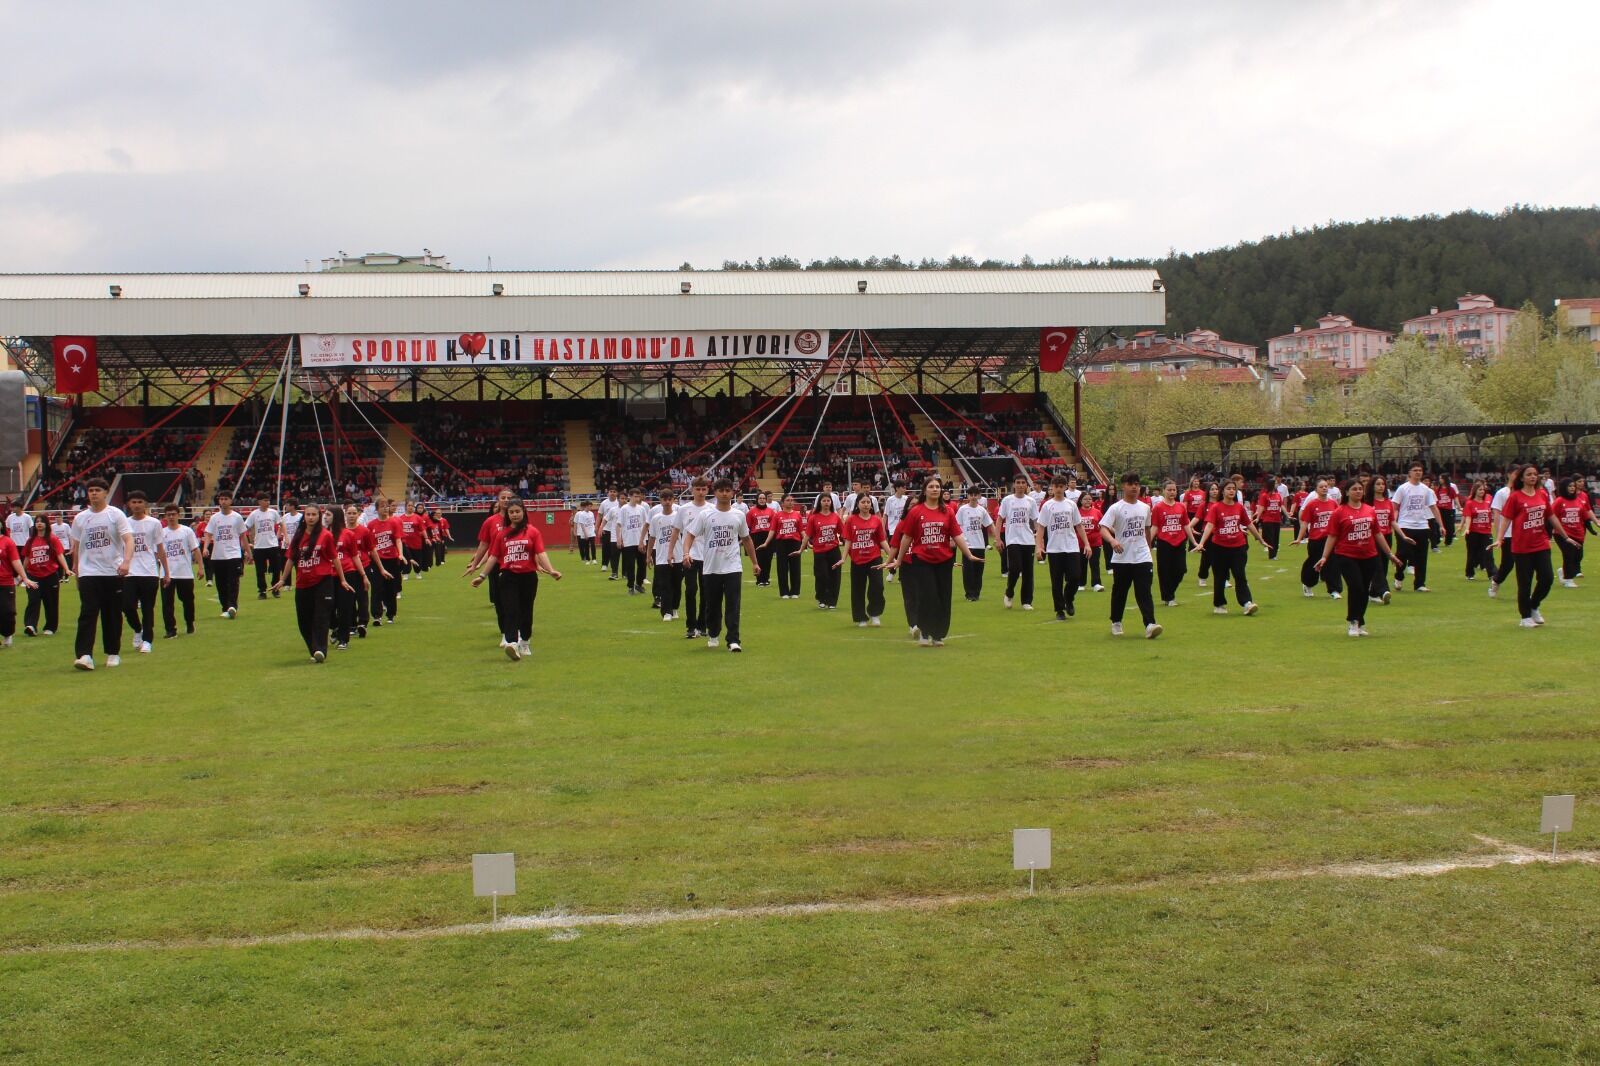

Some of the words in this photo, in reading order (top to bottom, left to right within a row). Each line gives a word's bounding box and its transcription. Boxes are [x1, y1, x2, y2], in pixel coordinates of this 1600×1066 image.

[352, 339, 436, 362] SPORUN
[533, 337, 695, 361] KASTAMONU'DA
[707, 334, 790, 357] ATIYOR!
